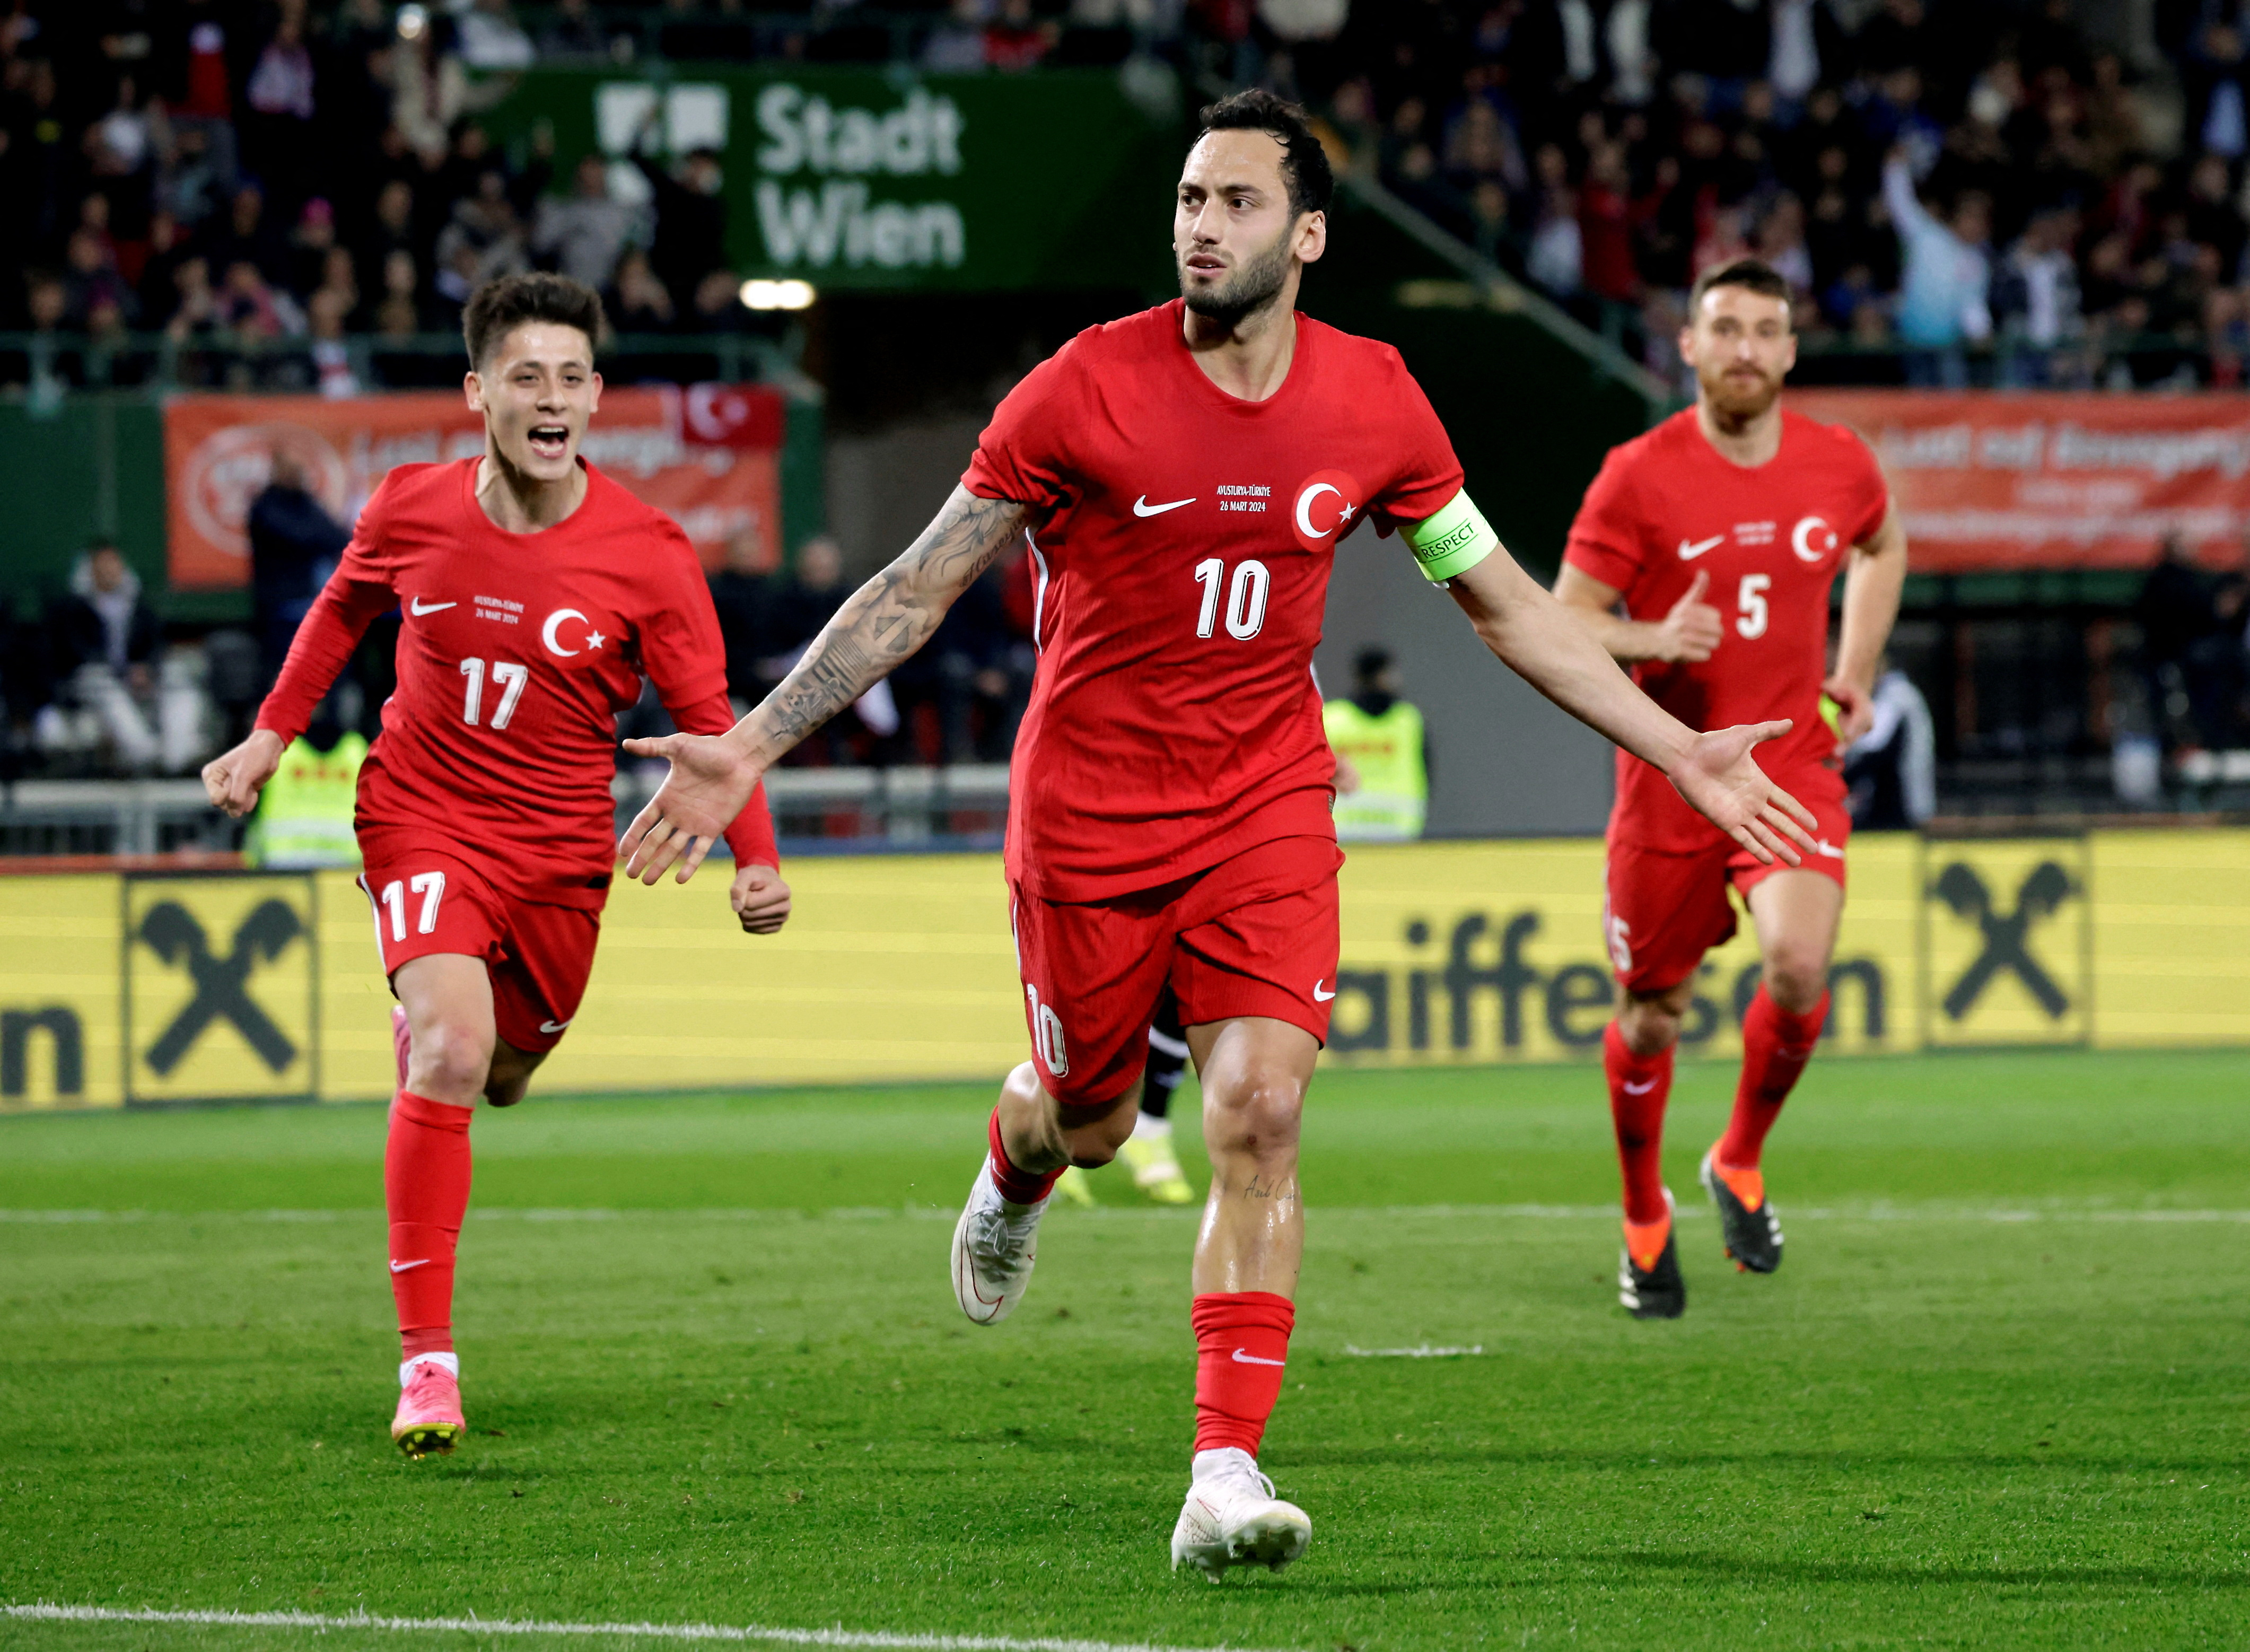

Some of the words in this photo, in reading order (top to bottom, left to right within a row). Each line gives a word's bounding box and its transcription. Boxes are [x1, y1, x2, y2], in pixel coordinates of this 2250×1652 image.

[755, 83, 962, 176] Stadt
[754, 179, 964, 267] Wien
[1216, 484, 1271, 496] AVUSTURYA-TÜRKİYE
[1220, 501, 1229, 511] 26
[1230, 501, 1248, 511] MART
[1249, 501, 1266, 512] 2024
[1421, 522, 1474, 558] RESPECT
[1195, 558, 1270, 641] 10
[1735, 573, 1772, 641] 5
[460, 657, 529, 730] 17
[381, 871, 446, 942] 17
[1610, 915, 1633, 972] 5
[1027, 983, 1069, 1078] 10
